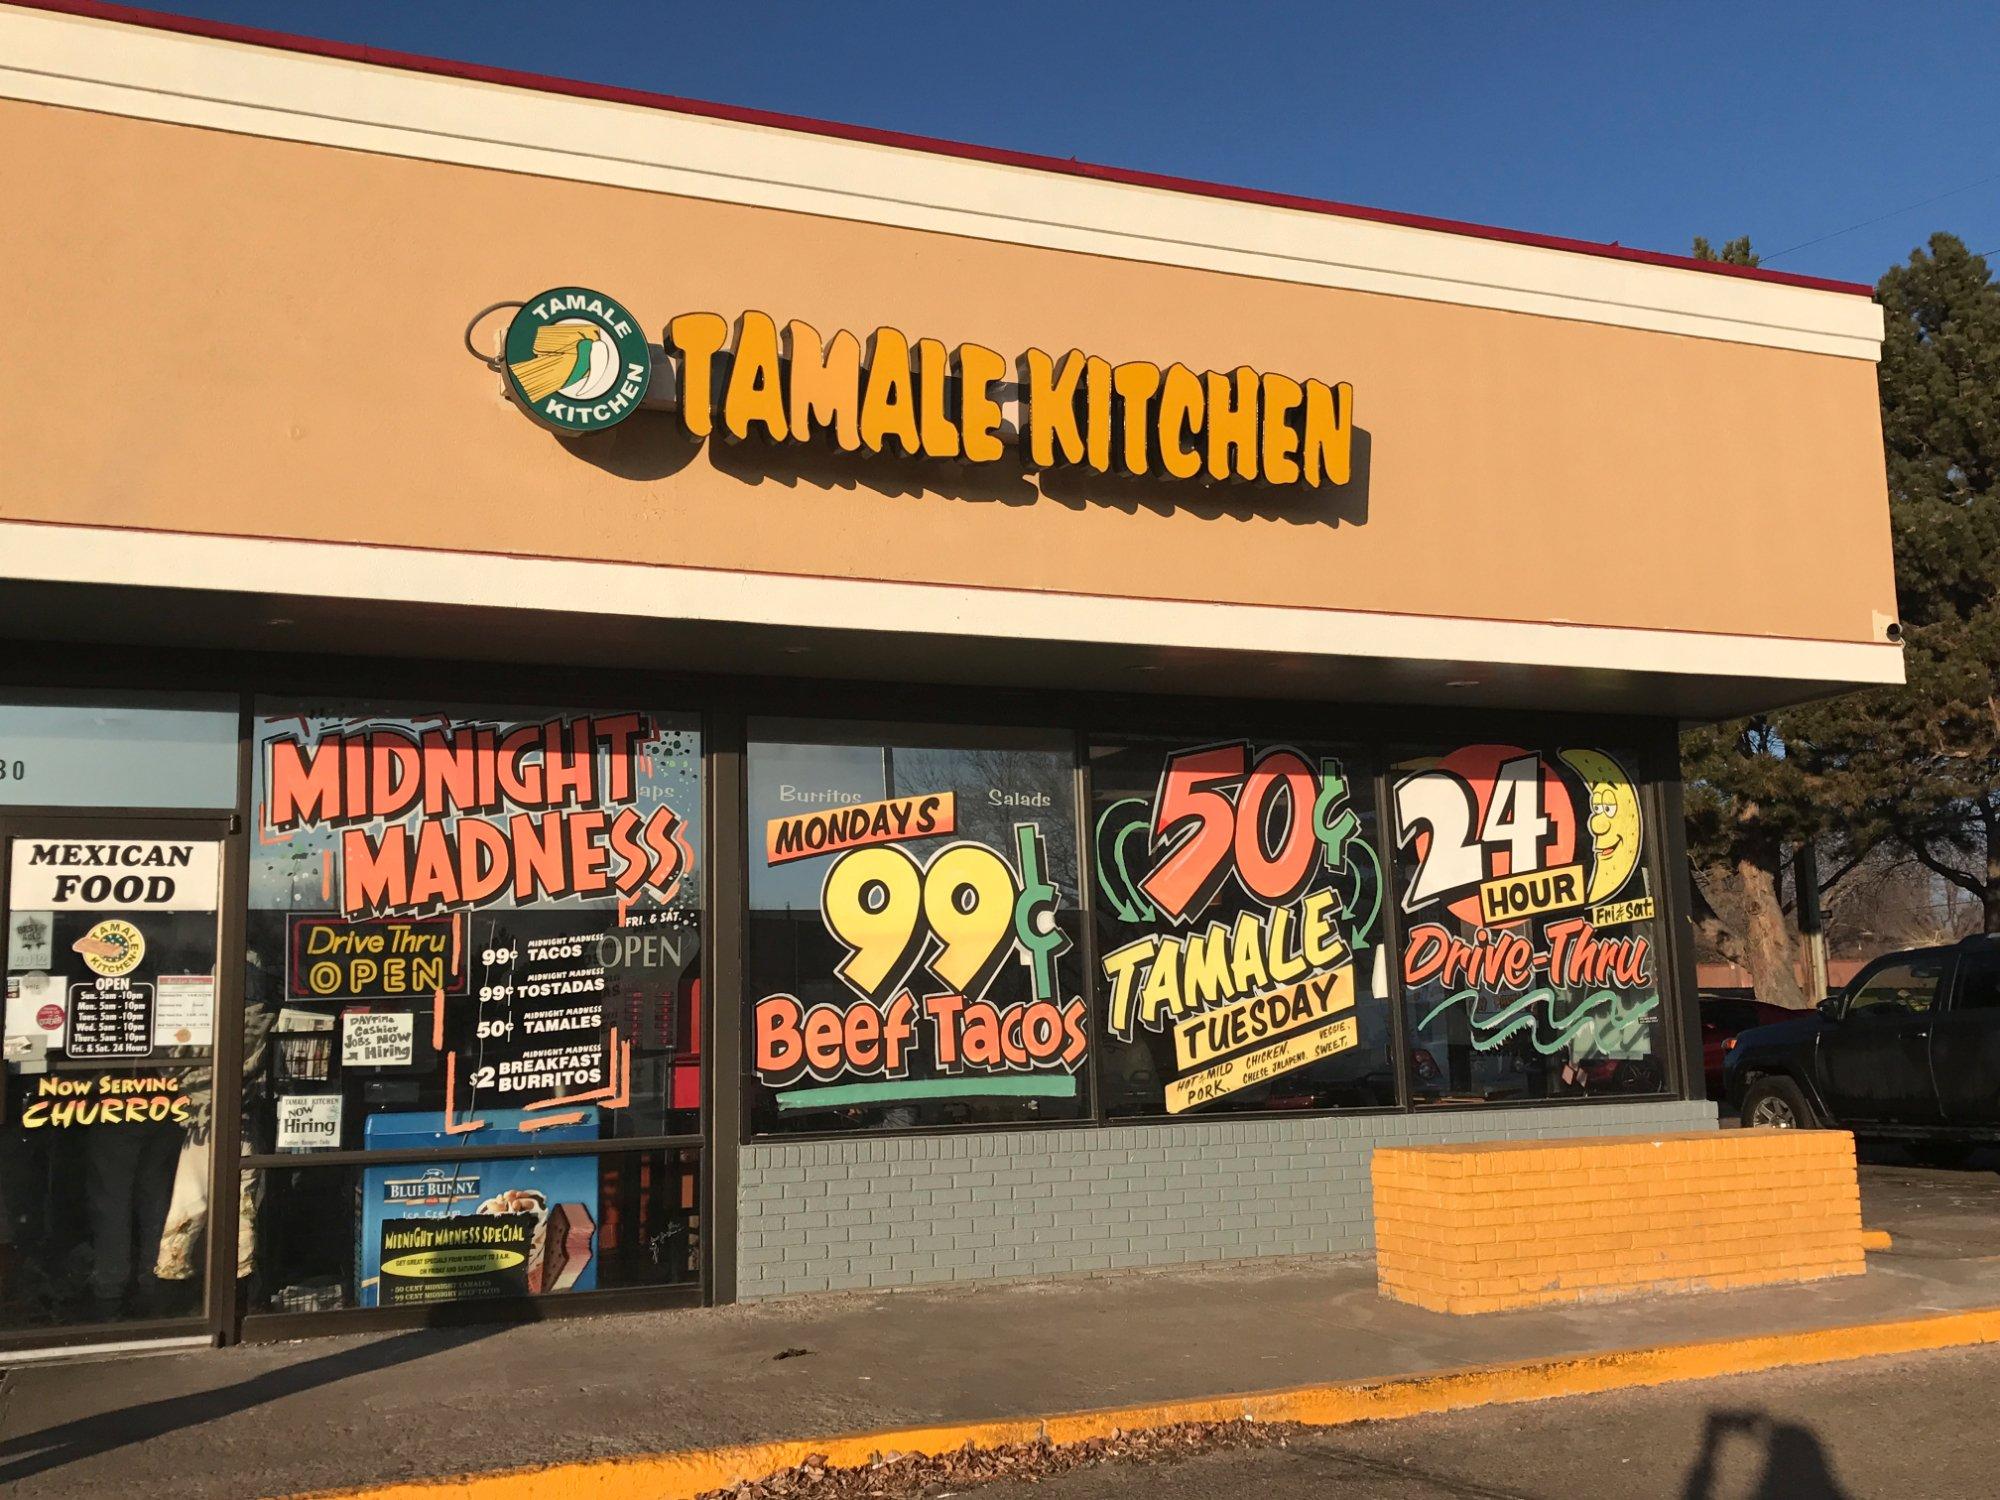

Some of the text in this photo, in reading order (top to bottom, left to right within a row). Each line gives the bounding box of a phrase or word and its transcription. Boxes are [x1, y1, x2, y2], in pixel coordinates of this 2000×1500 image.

[532, 294, 632, 339] TAMALE
[545, 363, 644, 424] KITCHEN
[663, 310, 1354, 488] TAMALE KITCHEN
[271, 713, 644, 828] MIDNIGHT
[779, 785, 861, 804] Burritos
[988, 789, 1051, 807] Salads
[774, 797, 940, 854] MONDAYS
[1139, 742, 1360, 920] 50¢
[1397, 756, 1548, 901] 24
[28, 844, 194, 866] MEXICAN
[342, 805, 683, 914] MADNESS
[52, 875, 175, 903] FOOD
[1487, 873, 1577, 918] HOUR
[625, 911, 682, 928] FRI. & SAT.
[824, 822, 1069, 1000] 99¢
[1596, 906, 1614, 923] Fri
[1626, 899, 1652, 919] Sat.
[91, 924, 139, 951] TAMALE
[307, 925, 446, 954] Drive Thru
[528, 933, 604, 948] MIDNIGHT MADNESS
[527, 944, 582, 961] TACOS
[596, 935, 682, 968] OPEN
[1404, 919, 1649, 987] Drive-Thru
[90, 954, 137, 973] KITCHEN
[1103, 888, 1349, 1037] TAMALE
[95, 978, 130, 990] OPEN
[309, 957, 443, 994] OPEN
[527, 967, 604, 981] MIDNIGHT MADNESS
[80, 991, 98, 1000] Sun.
[100, 990, 116, 1000] 5am
[518, 978, 604, 998] TOSTADAS
[77, 1002, 97, 1011] Mon.
[100, 1001, 116, 1010] 5am
[124, 1001, 145, 1011] 10pm
[79, 1012, 97, 1021] Tues.
[100, 1012, 116, 1020] 5am
[524, 1005, 602, 1020] MIDNIGHT MADNESS
[76, 1023, 96, 1031] Wed.
[99, 1022, 115, 1031] 5am
[123, 1022, 145, 1032] 10pm
[524, 1015, 602, 1034] TAMALES
[1183, 975, 1338, 1059] TUESDAY
[74, 1033, 97, 1042] Thurs.
[100, 1032, 116, 1041] 5am
[124, 1033, 146, 1043] 10pm
[354, 1026, 398, 1037] Cashier
[376, 1032, 411, 1044] NOW
[755, 992, 915, 1080] Beef
[926, 993, 1087, 1069] Tacos
[71, 1043, 147, 1053] Fri. & Sat. 24 Hours
[365, 1045, 410, 1060] Hiring
[523, 1044, 602, 1058] MIDNIGHT MADNESS
[469, 1054, 602, 1088] $2 BREAKFAST
[499, 1068, 602, 1092] BURRITOS
[1177, 1077, 1196, 1092] HOT
[1207, 1062, 1233, 1080] MILD
[1242, 1069, 1268, 1084] CHEESE
[38, 1075, 179, 1097] NOW SERVING
[22, 1096, 192, 1129] CHURROS
[288, 1104, 314, 1118] NOW
[284, 1118, 336, 1136] Hiring
[390, 1185, 425, 1198] BLUE
[403, 1210, 419, 1218] Ice
[435, 1226, 480, 1246] MADNESS
[481, 1224, 525, 1243] SPECIAL
[424, 1290, 457, 1298] MIDNIGHT
